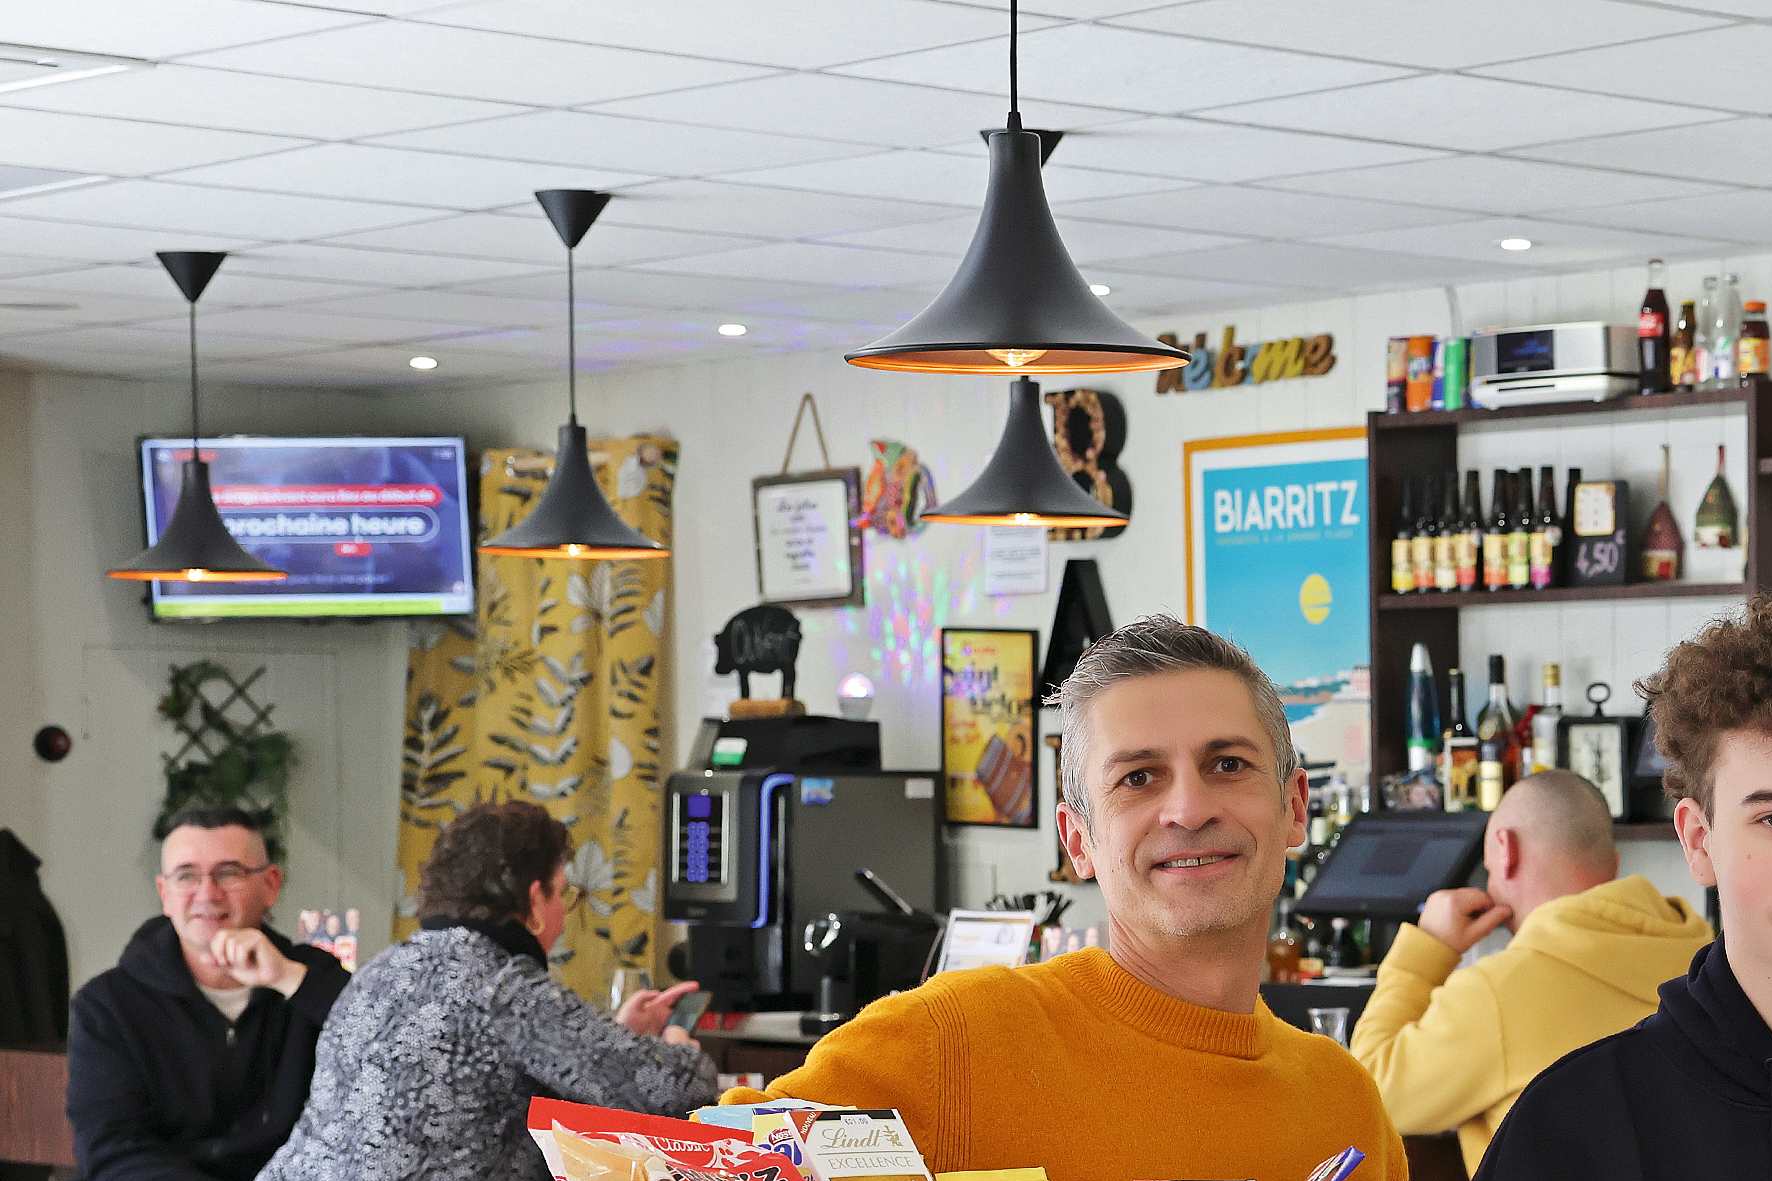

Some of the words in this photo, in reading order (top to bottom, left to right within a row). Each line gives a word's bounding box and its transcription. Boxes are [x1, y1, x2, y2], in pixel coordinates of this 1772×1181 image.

[1214, 479, 1361, 534] BIARRITZ
[820, 1126, 883, 1149] Lindt
[829, 1155, 914, 1170] EXCELLENCE
